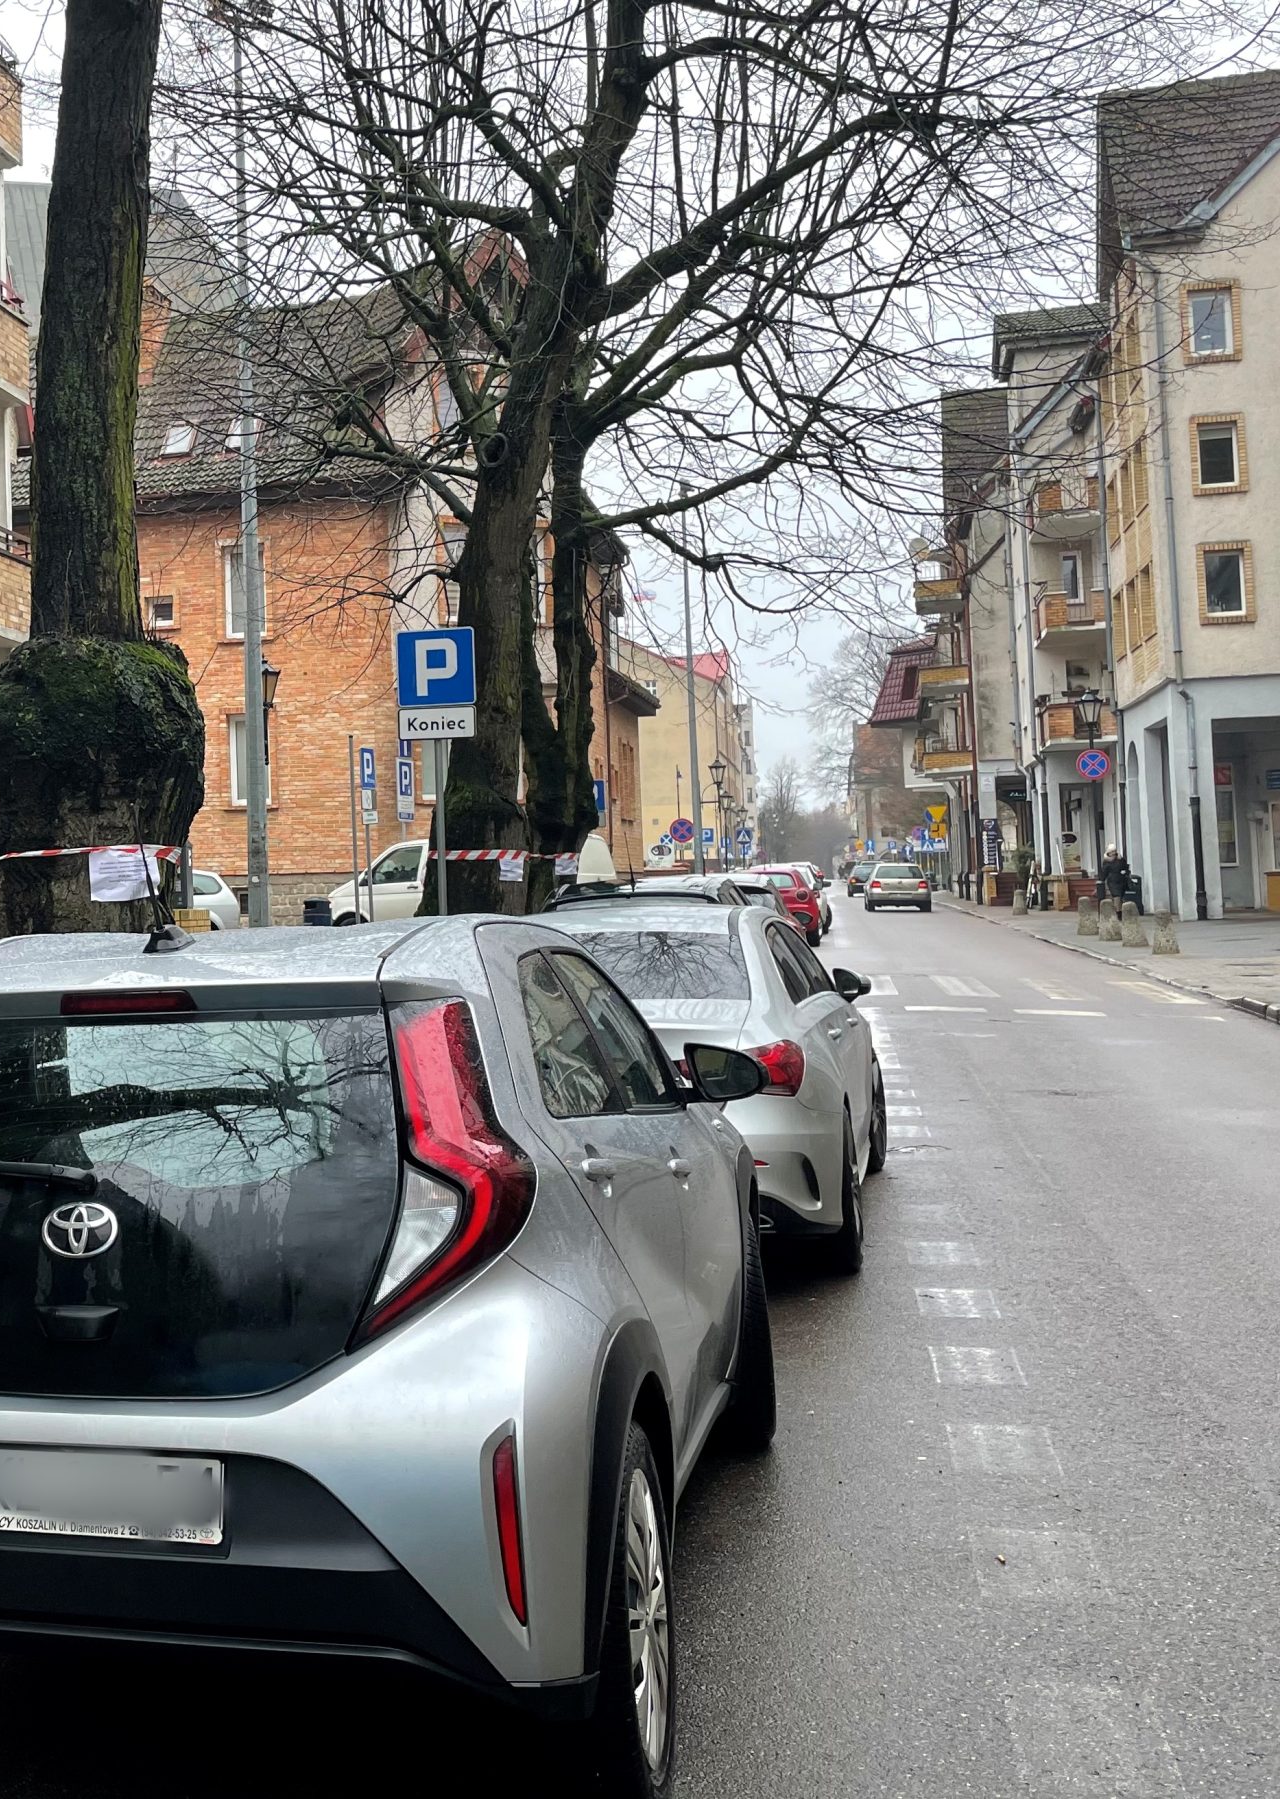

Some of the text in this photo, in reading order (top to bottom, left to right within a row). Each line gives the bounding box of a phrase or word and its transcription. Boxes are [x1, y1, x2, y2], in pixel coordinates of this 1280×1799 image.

[414, 638, 458, 697] P
[407, 716, 466, 732] Koniec
[363, 752, 373, 784] P
[401, 765, 410, 793] P
[702, 829, 711, 842] P
[16, 1518, 57, 1532] KOSZALIN
[59, 1522, 68, 1532] ul.
[70, 1521, 119, 1535] Diamentowa
[120, 1525, 126, 1536] 2
